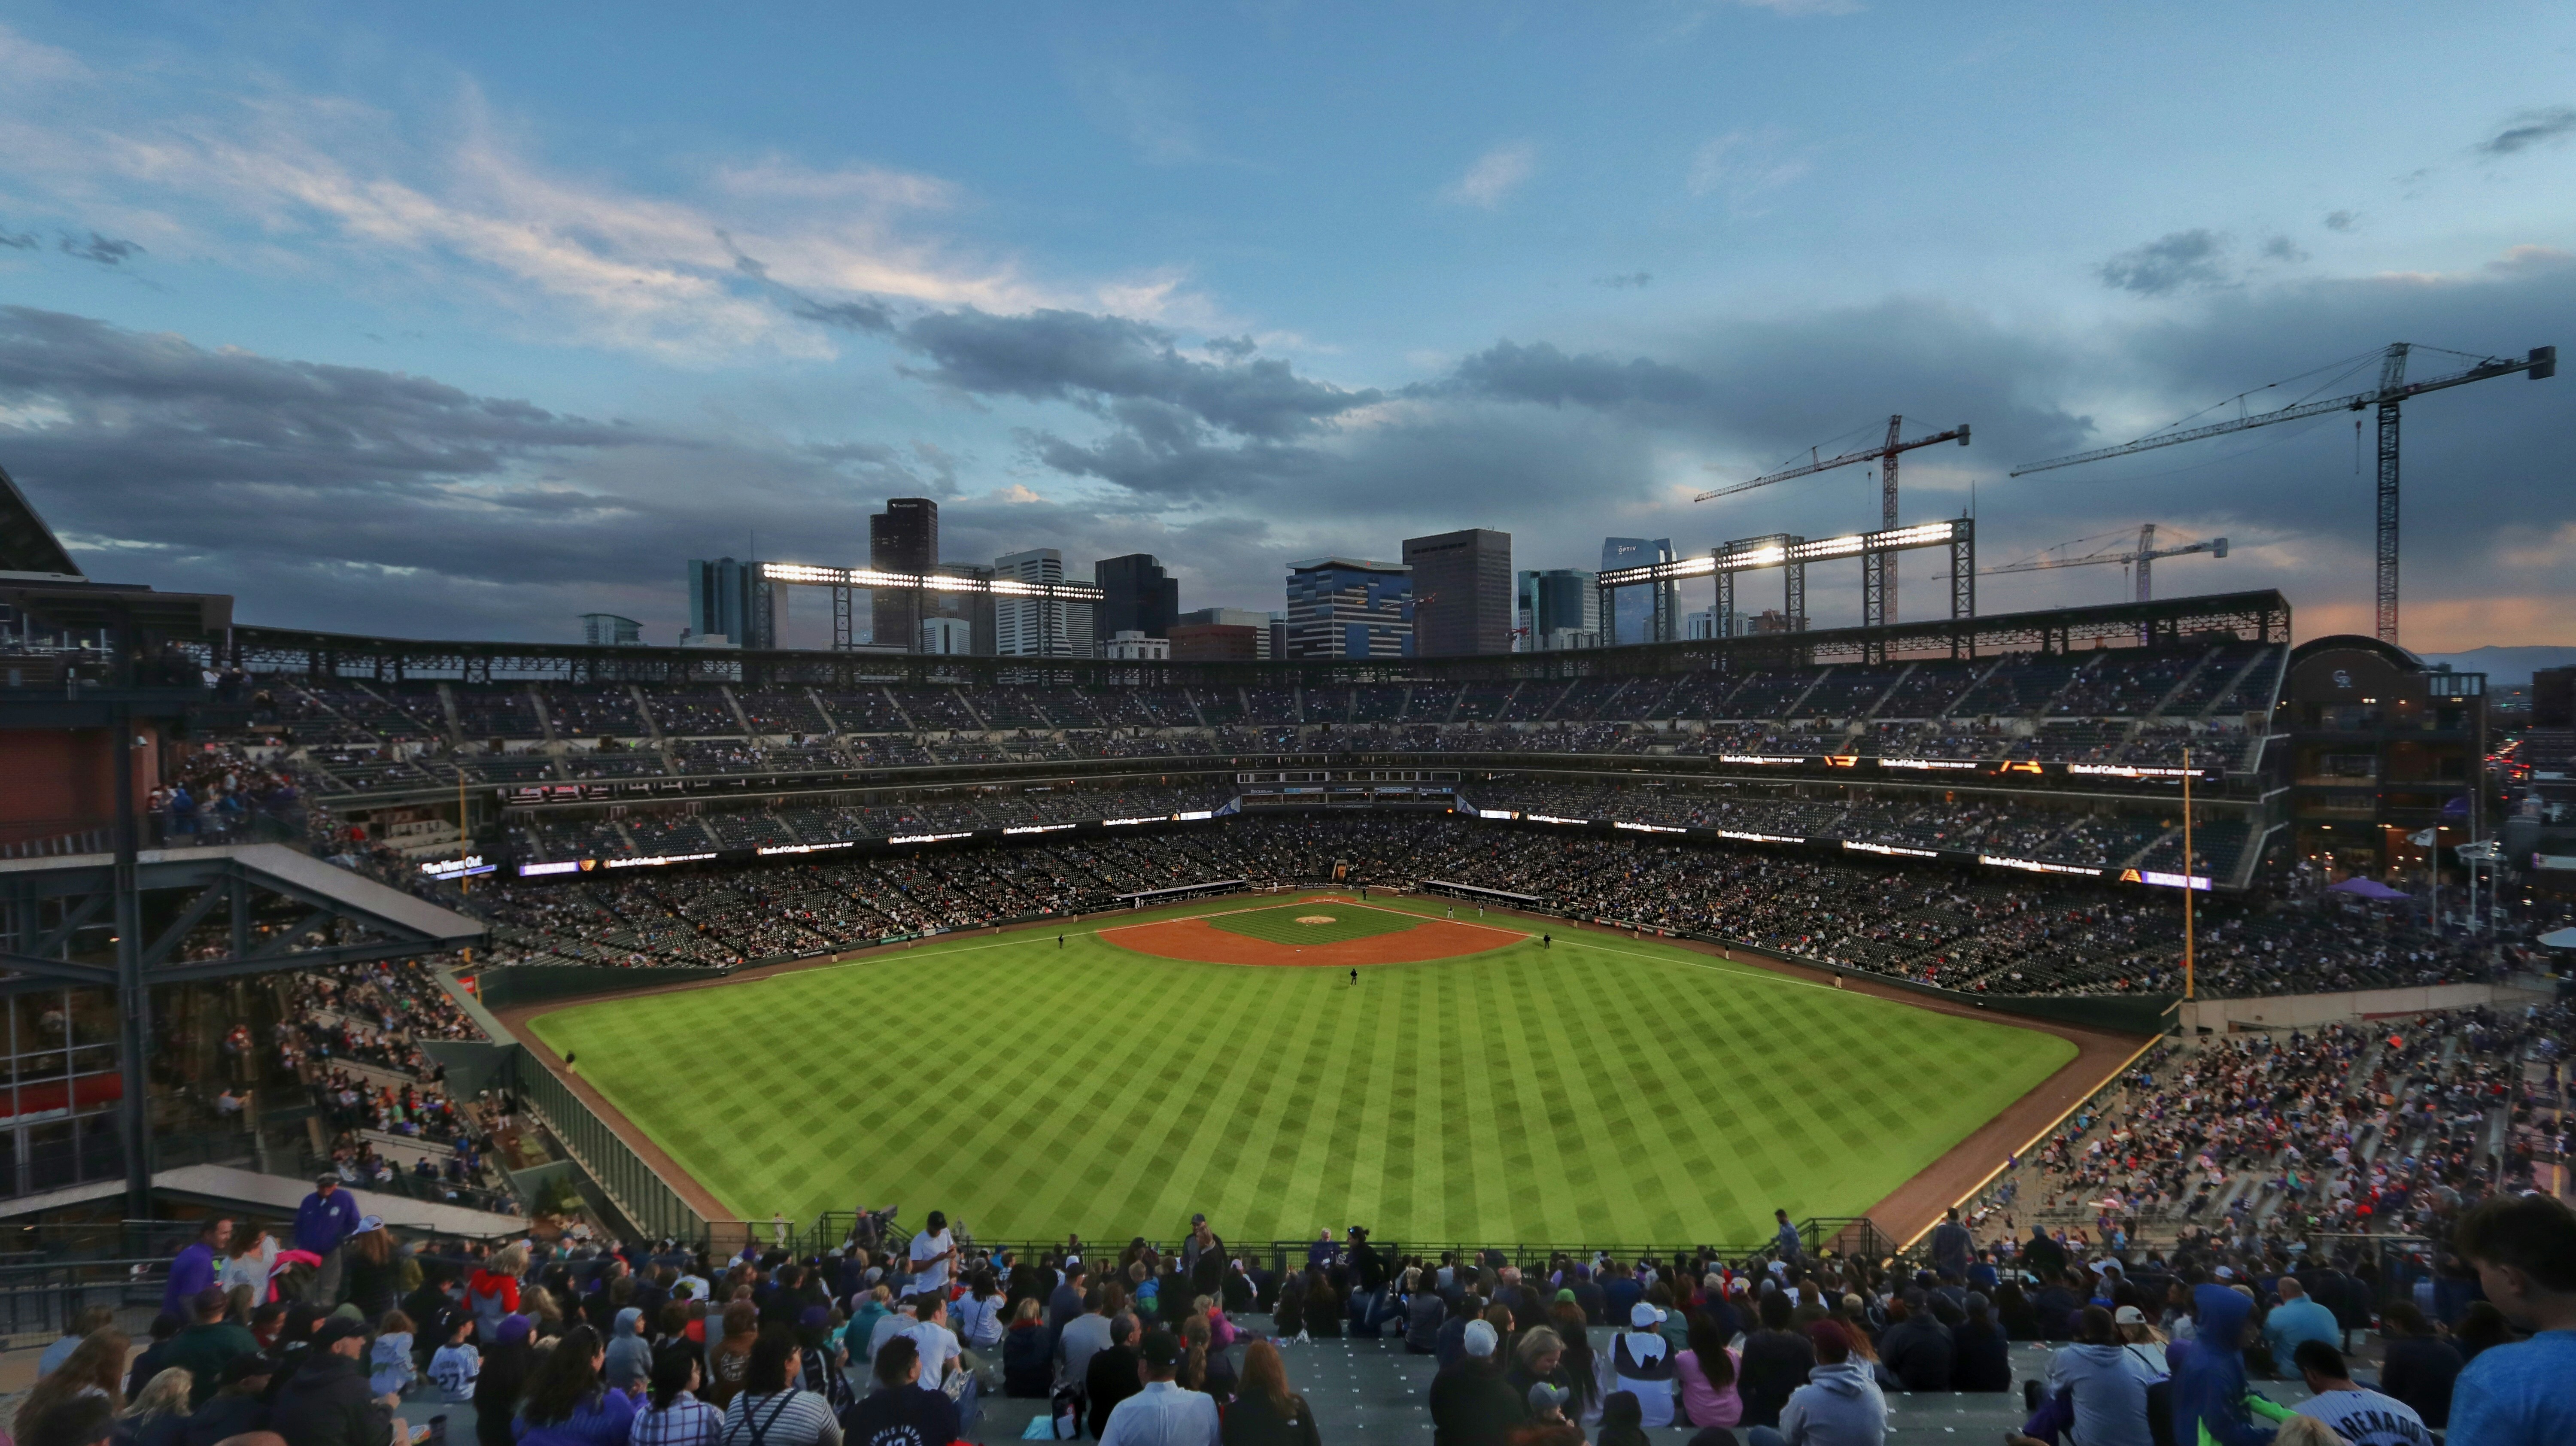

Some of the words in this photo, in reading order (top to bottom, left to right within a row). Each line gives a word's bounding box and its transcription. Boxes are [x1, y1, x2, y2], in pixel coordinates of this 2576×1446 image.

[1619, 545, 1636, 555] OPTIV
[1903, 759, 1929, 768] Colorado
[2074, 765, 2093, 773] Bank
[2092, 765, 2101, 773] of
[2101, 766, 2136, 775] Colorado
[1866, 844, 1891, 853] Colorado
[422, 863, 442, 874] Five
[441, 860, 465, 872] Years
[465, 855, 483, 868] Out
[610, 859, 627, 867] Bank
[635, 856, 666, 865] Colorado
[1985, 857, 2001, 865] Bank
[2009, 859, 2041, 869] Colorado
[438, 1373, 460, 1392] 27
